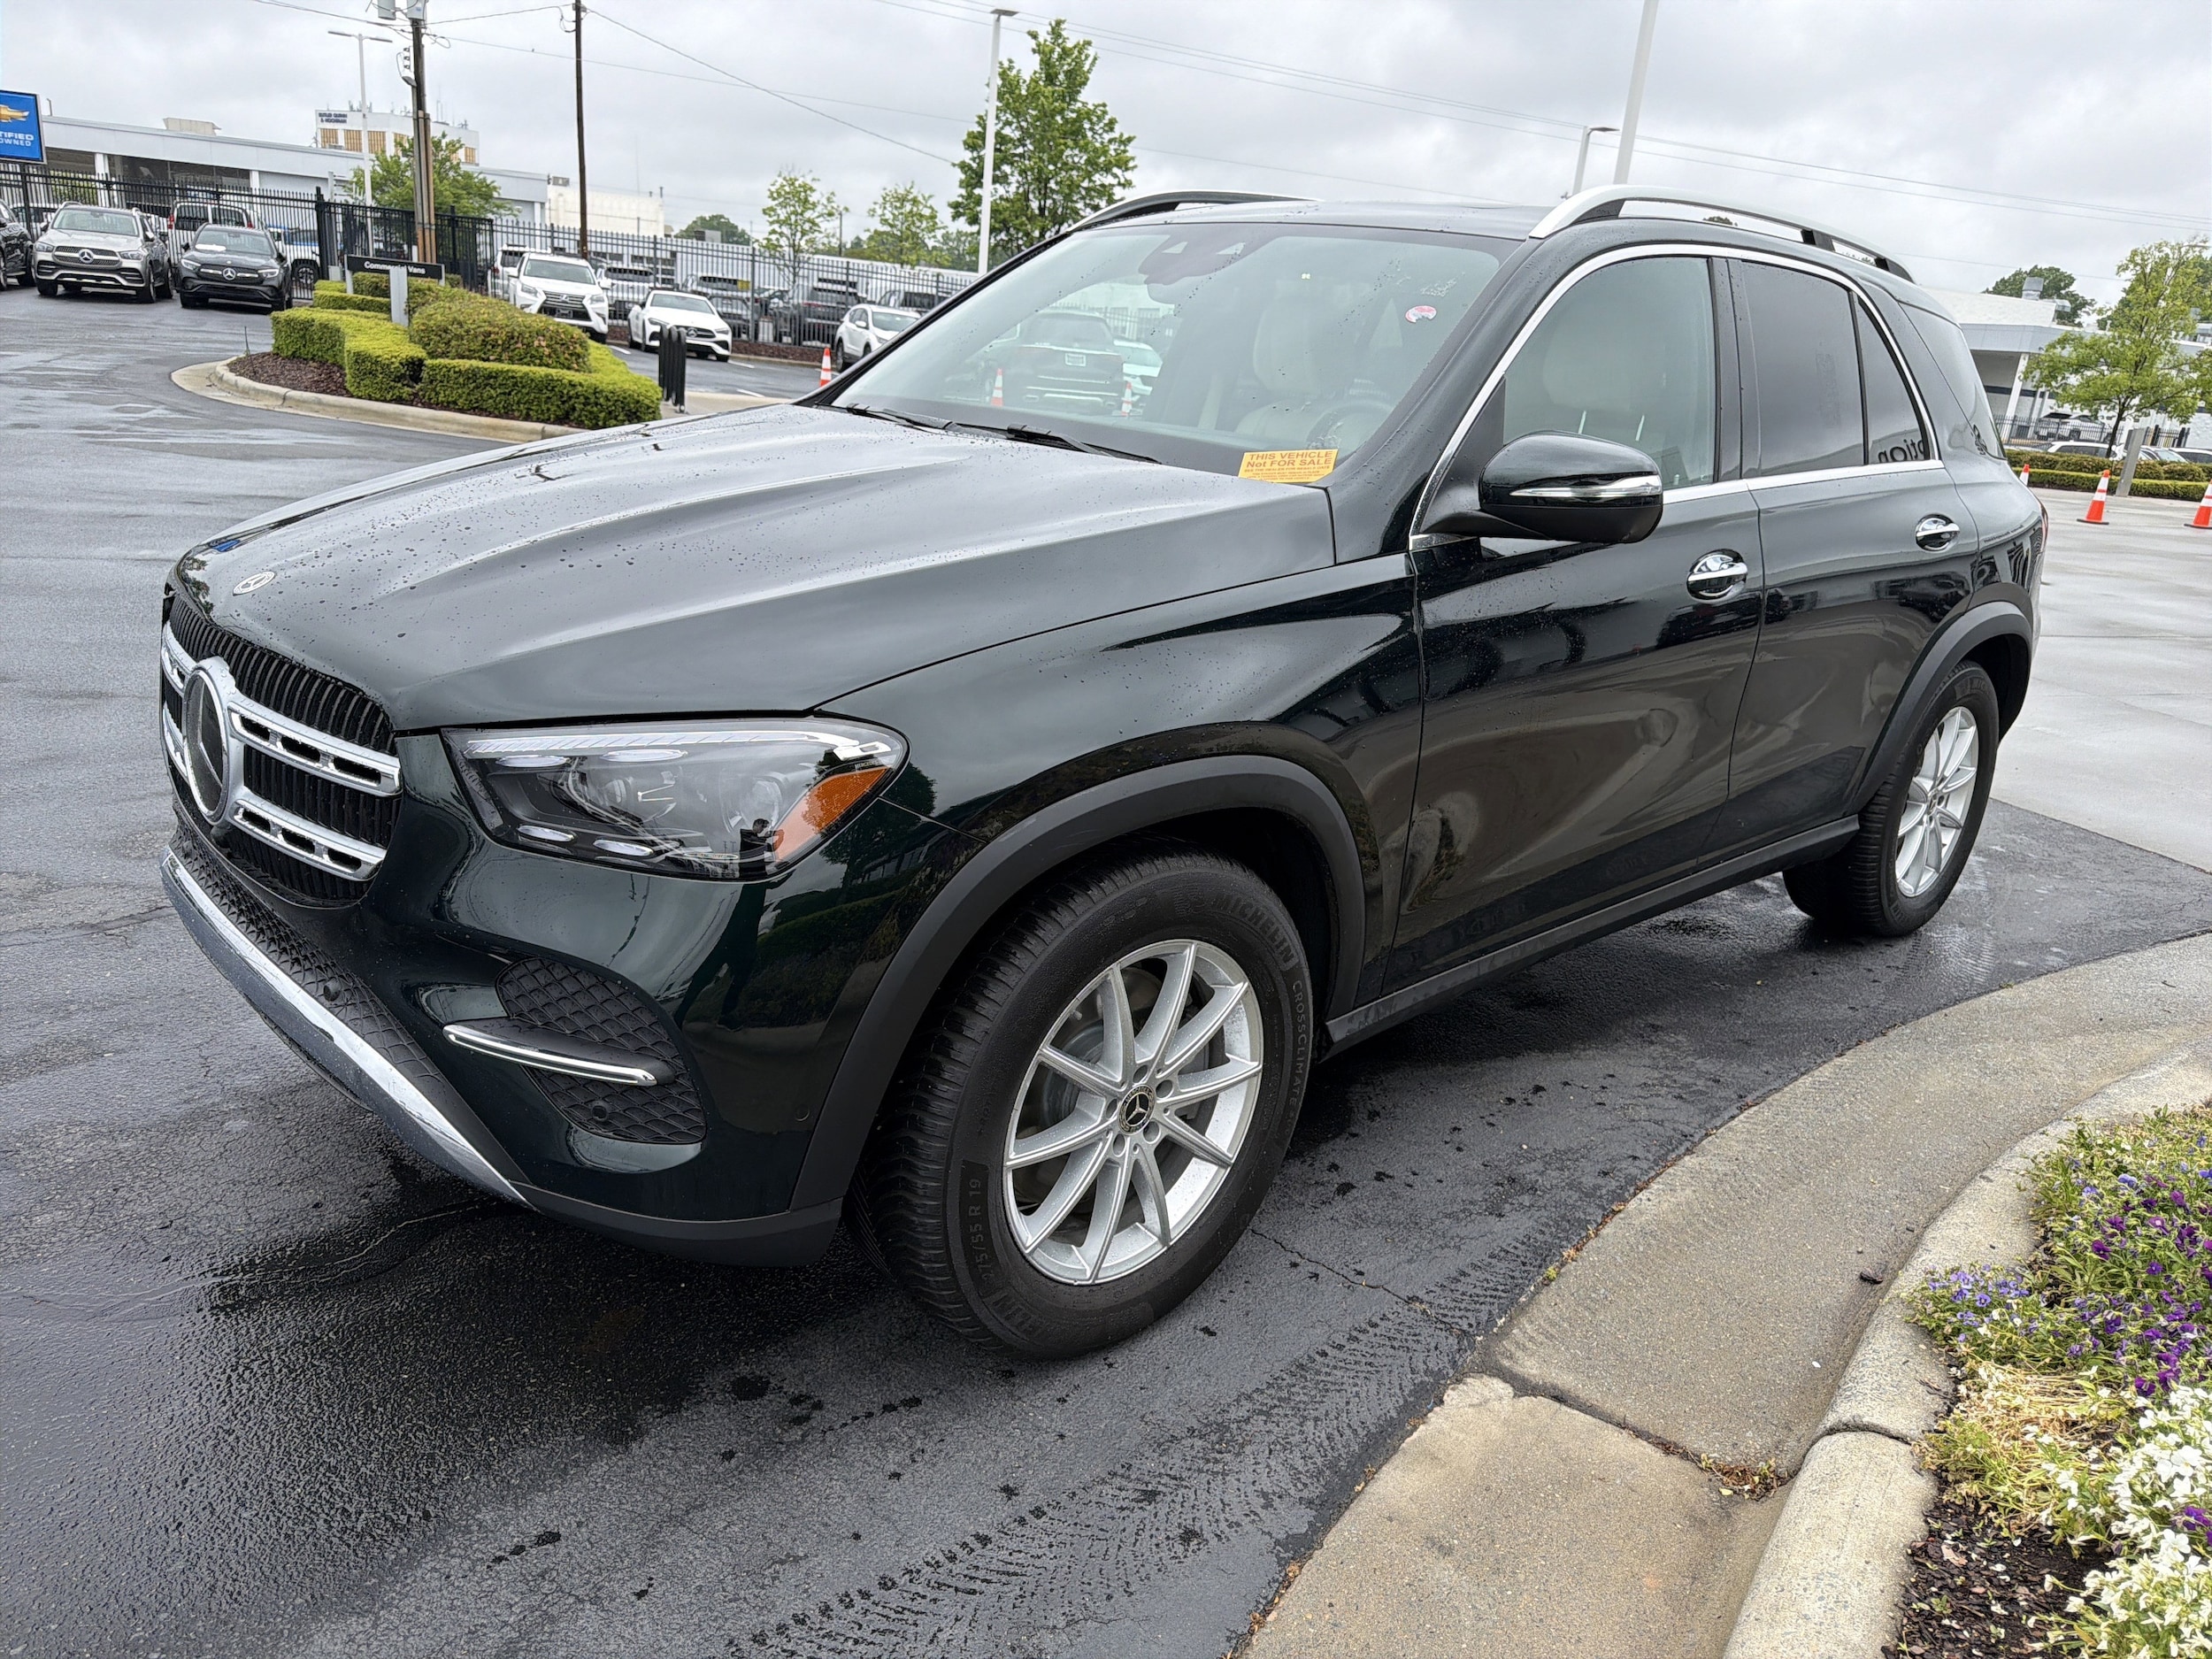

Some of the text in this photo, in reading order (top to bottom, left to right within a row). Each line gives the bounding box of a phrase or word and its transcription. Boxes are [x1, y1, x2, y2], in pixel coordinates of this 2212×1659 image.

[408, 265, 426, 274] Vans
[1216, 892, 1294, 964] MICHELIN
[1289, 979, 1308, 1107] CROSSCLIMATE
[968, 1178, 982, 1197] 19
[968, 1204, 982, 1217] R
